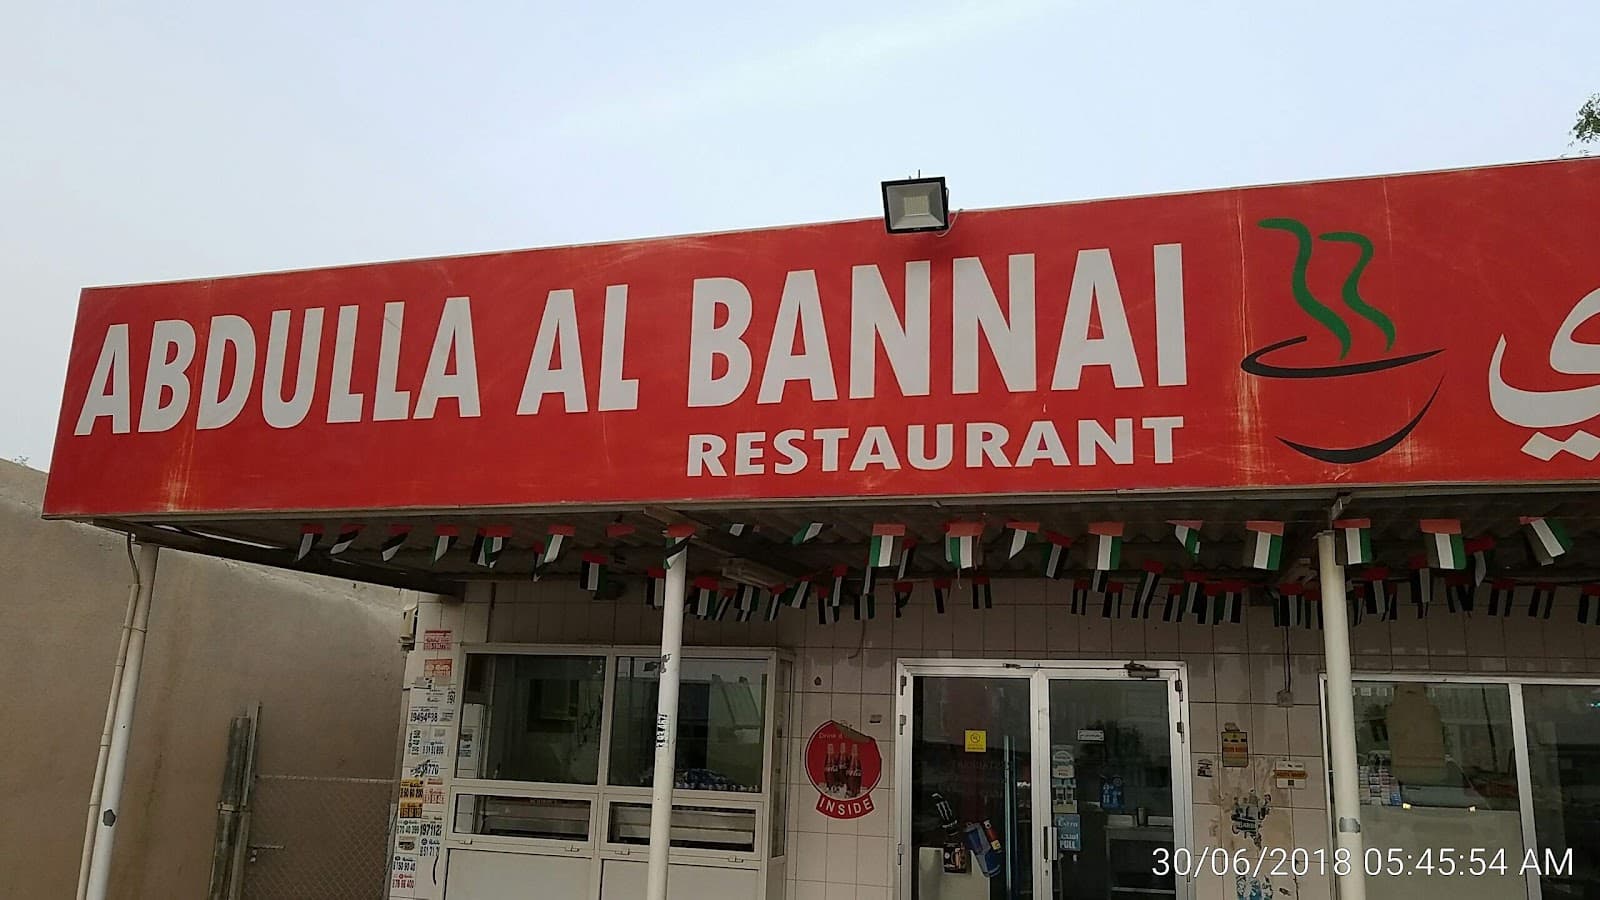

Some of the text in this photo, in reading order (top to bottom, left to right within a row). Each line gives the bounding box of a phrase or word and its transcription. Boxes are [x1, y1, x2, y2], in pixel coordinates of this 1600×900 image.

[74, 243, 1187, 435] ABDULLA AL BANNAI
[687, 416, 1183, 477] RESTAURANT
[819, 798, 872, 815] INSIDE
